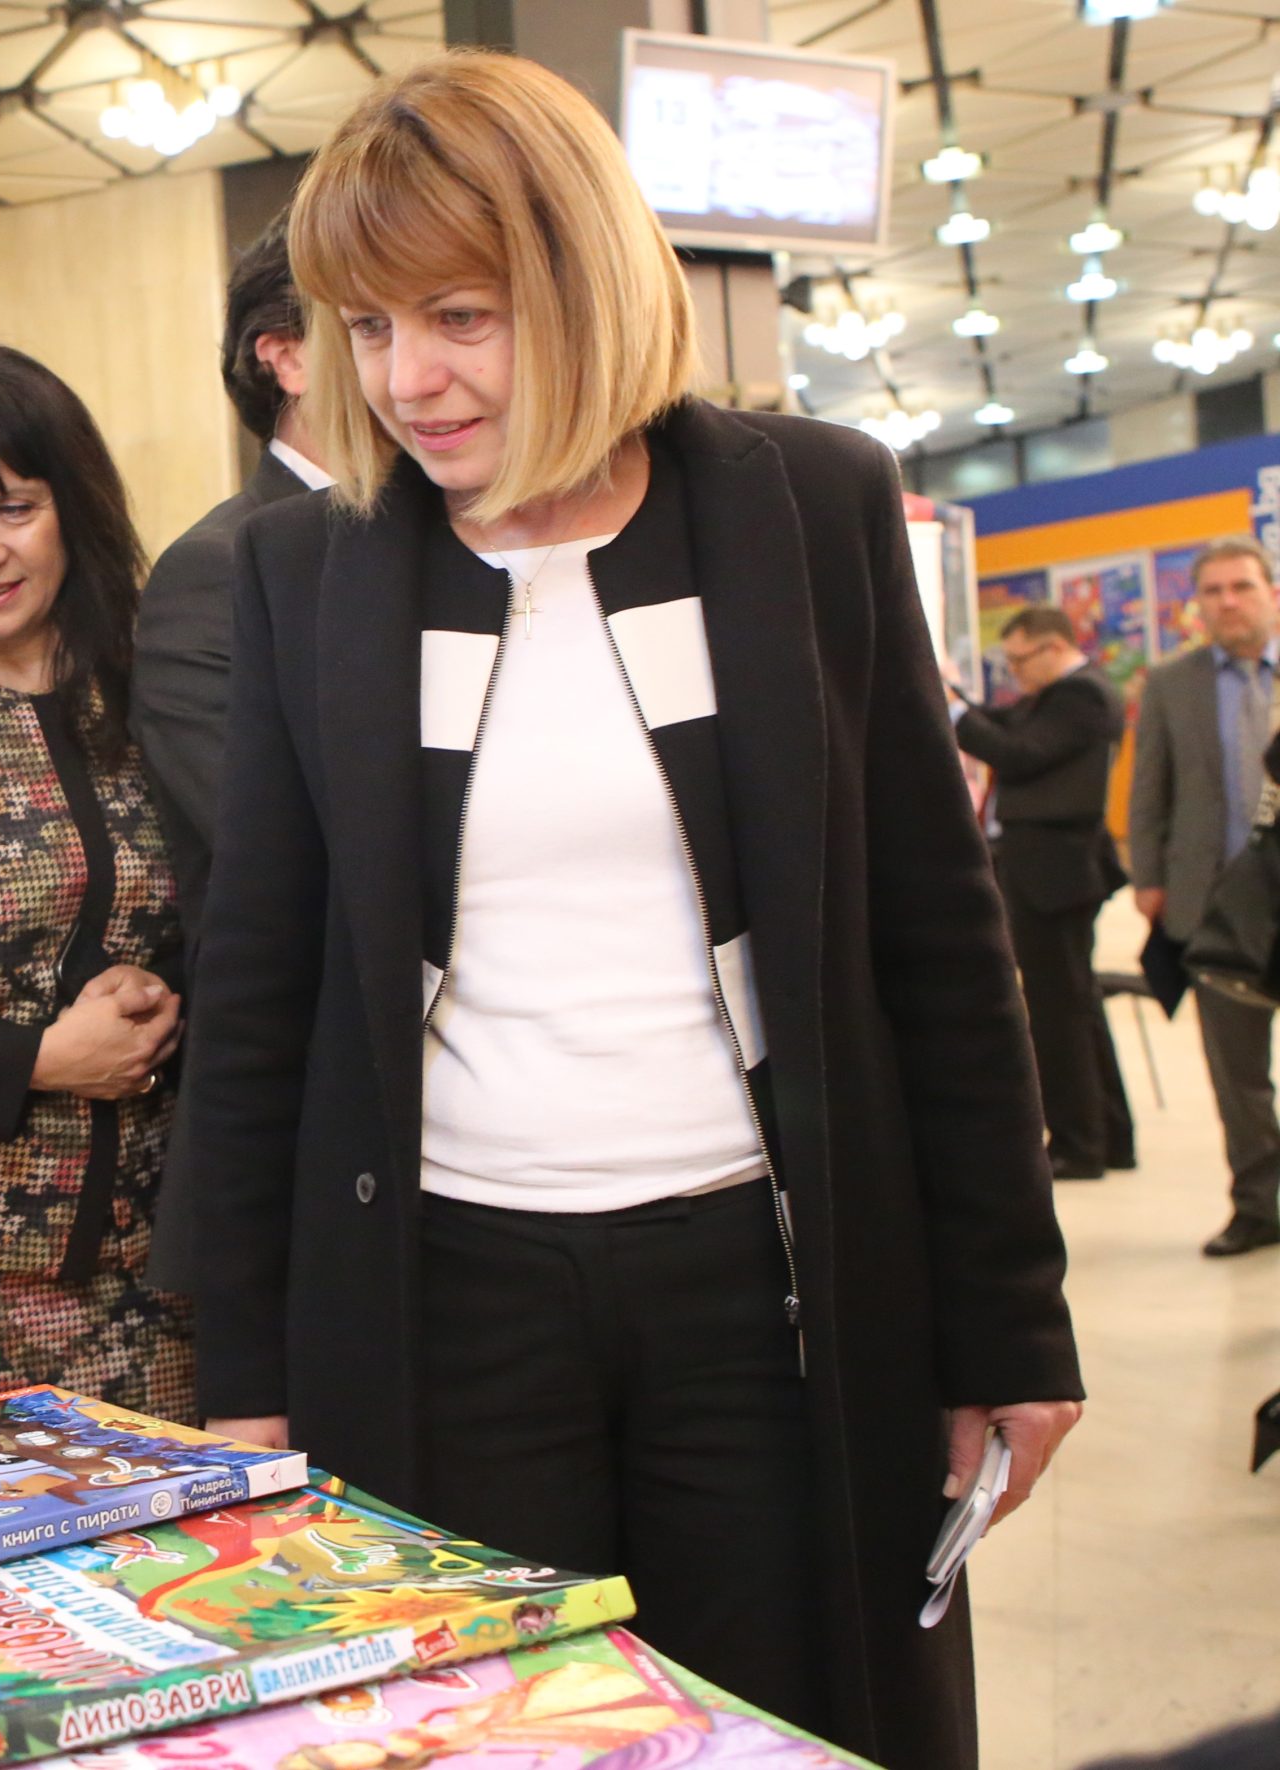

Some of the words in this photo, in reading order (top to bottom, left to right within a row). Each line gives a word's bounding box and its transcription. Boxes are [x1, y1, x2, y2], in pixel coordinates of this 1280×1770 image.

[1, 1523, 56, 1552] книга
[59, 1520, 71, 1535] с
[75, 1503, 141, 1532] пирати
[59, 1668, 252, 1750] ДИНОЗАВРИ
[258, 1638, 397, 1695] ЗАНИМАТЕЛНА
